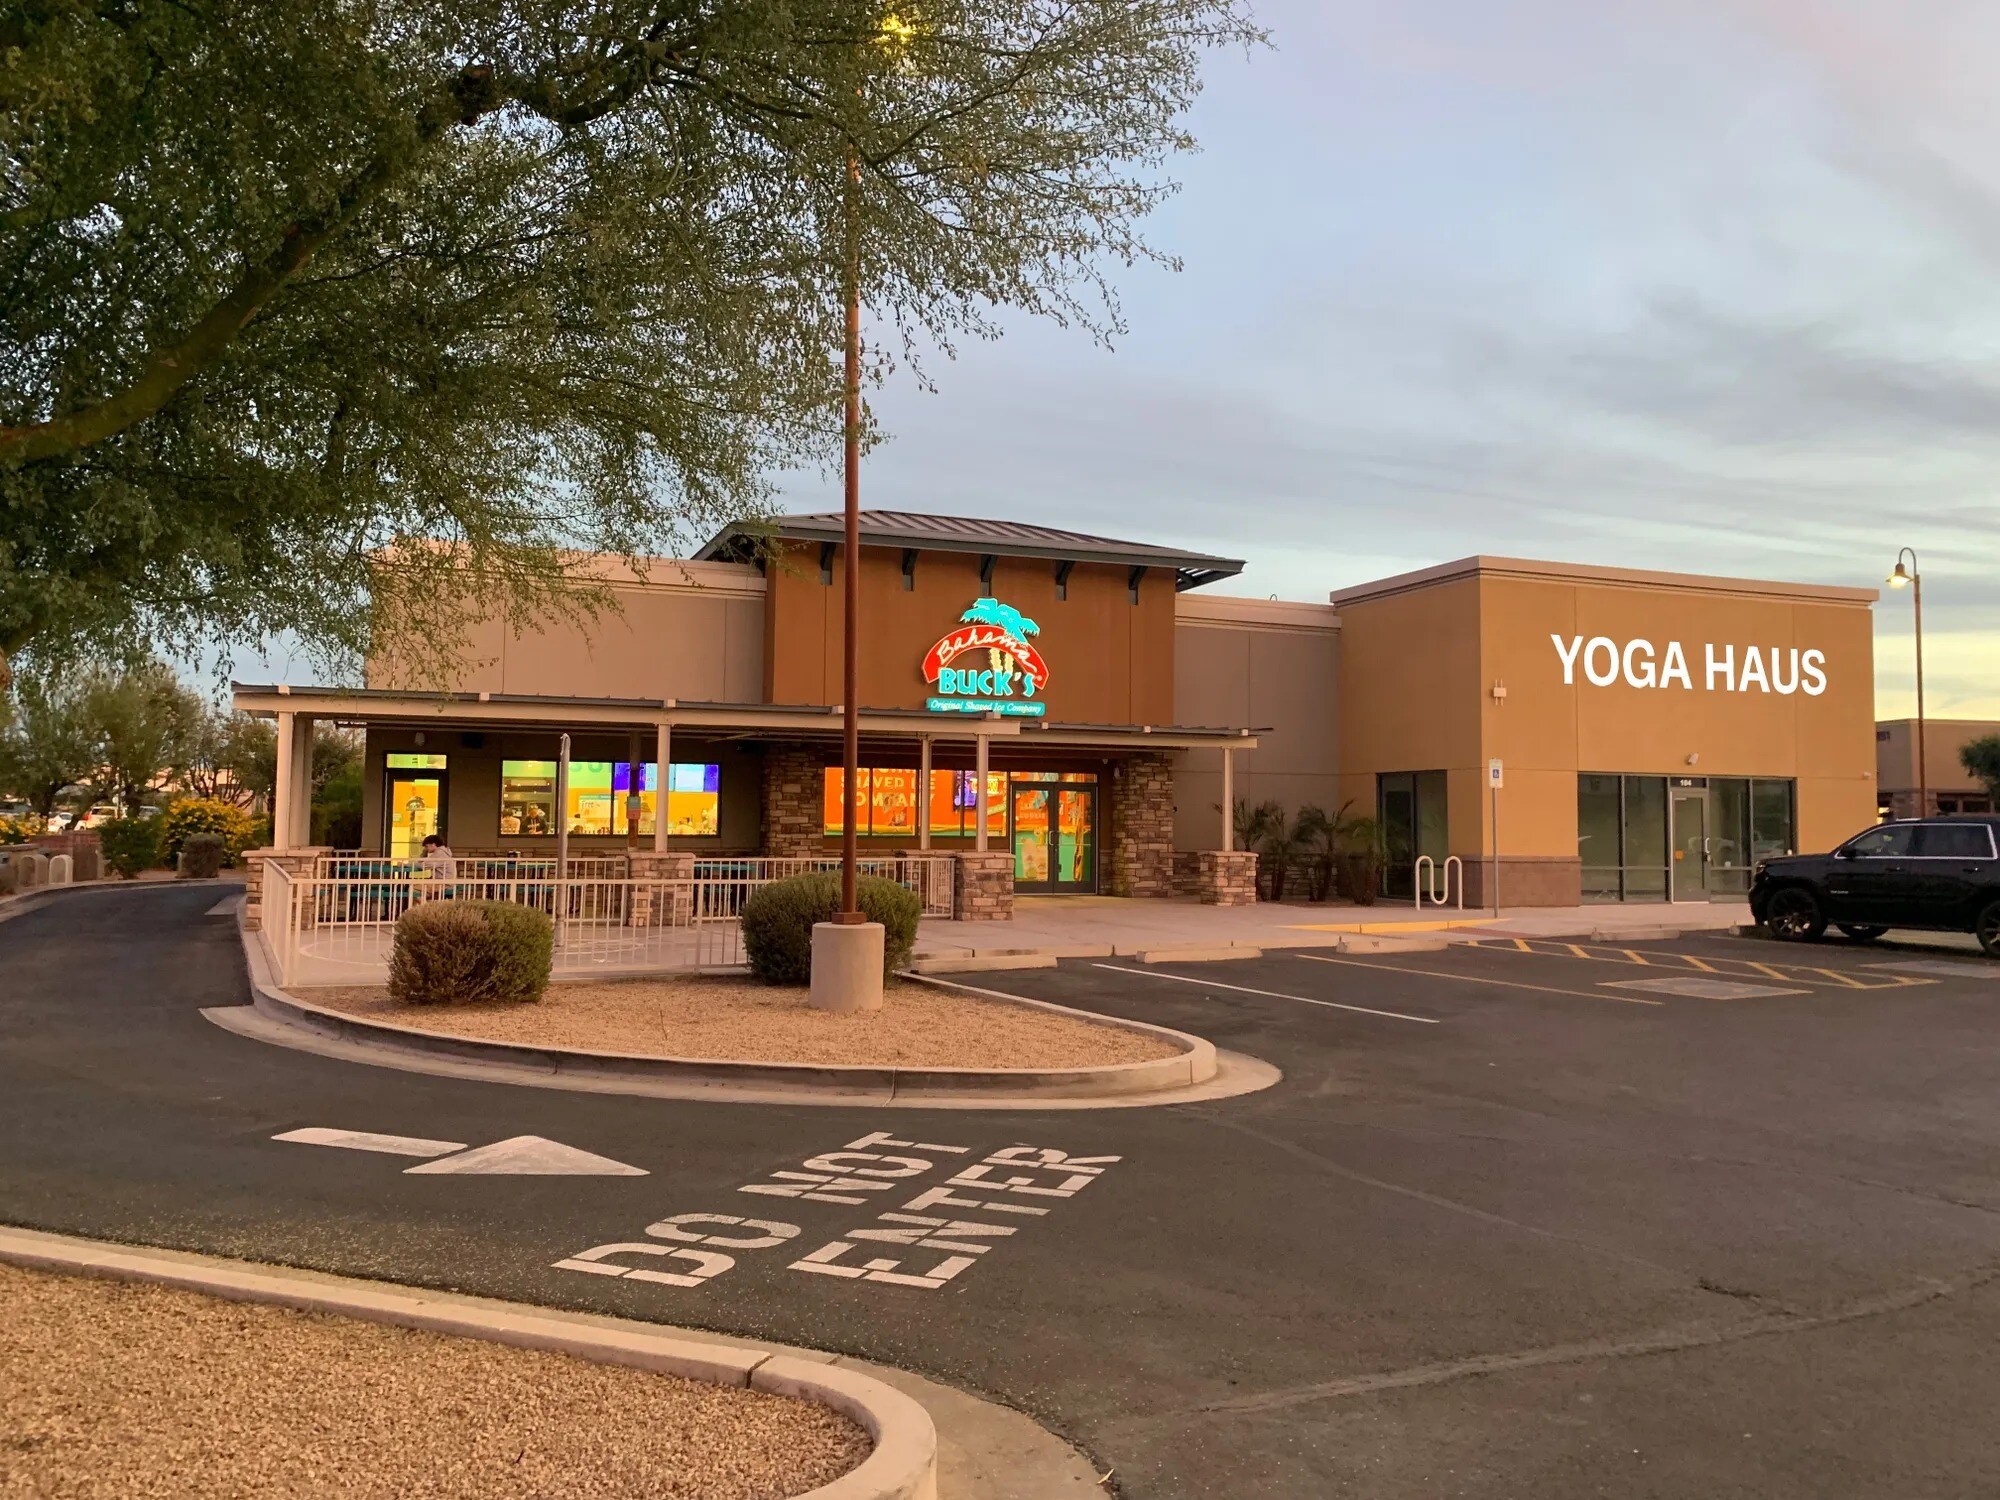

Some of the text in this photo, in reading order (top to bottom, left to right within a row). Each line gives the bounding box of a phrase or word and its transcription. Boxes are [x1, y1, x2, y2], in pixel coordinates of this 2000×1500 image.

[936, 627, 1038, 674] Bahama
[1550, 634, 1827, 696] YOGA HAUS
[930, 700, 1042, 714] Original Shaved Ice Company
[550, 1131, 971, 1288] DO NOT
[786, 1147, 1122, 1289] ENTER
